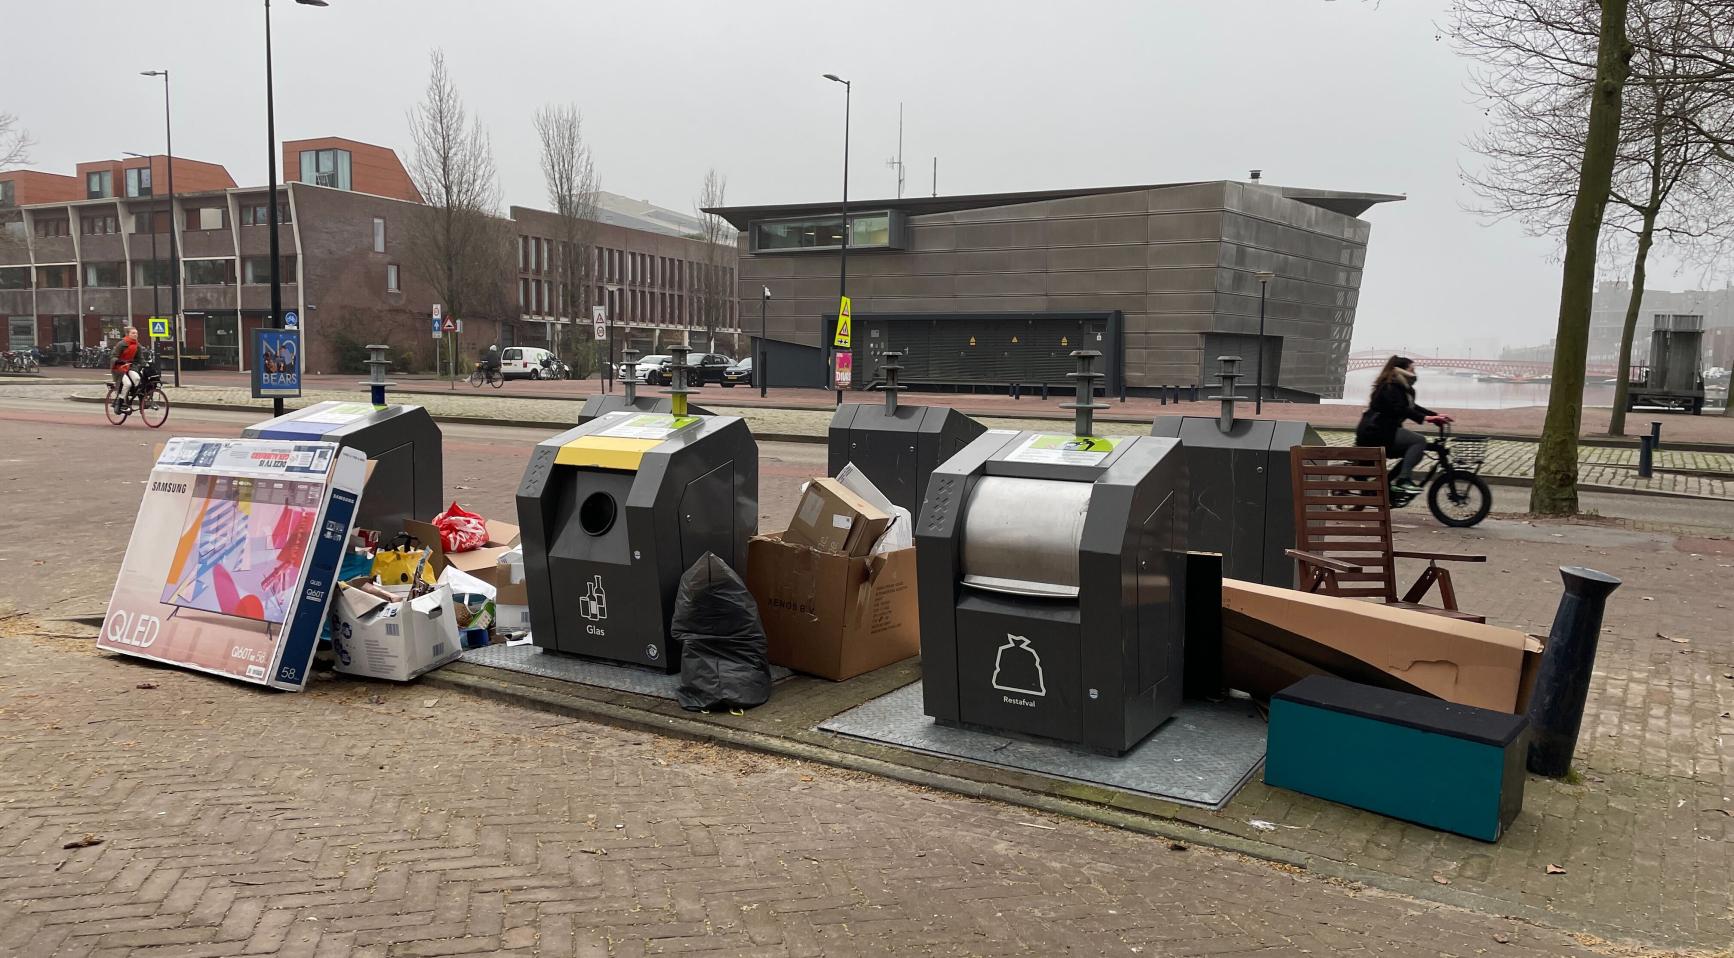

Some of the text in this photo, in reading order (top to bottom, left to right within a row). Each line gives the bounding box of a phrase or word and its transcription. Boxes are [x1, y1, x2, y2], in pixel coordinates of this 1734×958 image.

[263, 373, 297, 385] BEARS
[152, 482, 187, 494] SAMSUNG
[306, 588, 325, 598] Q60T
[107, 610, 160, 648] QLED
[586, 624, 605, 636] Glas
[231, 646, 253, 661] Q60T
[256, 650, 266, 664] 58
[281, 666, 296, 680] 58
[1003, 696, 1036, 707] Restafval
